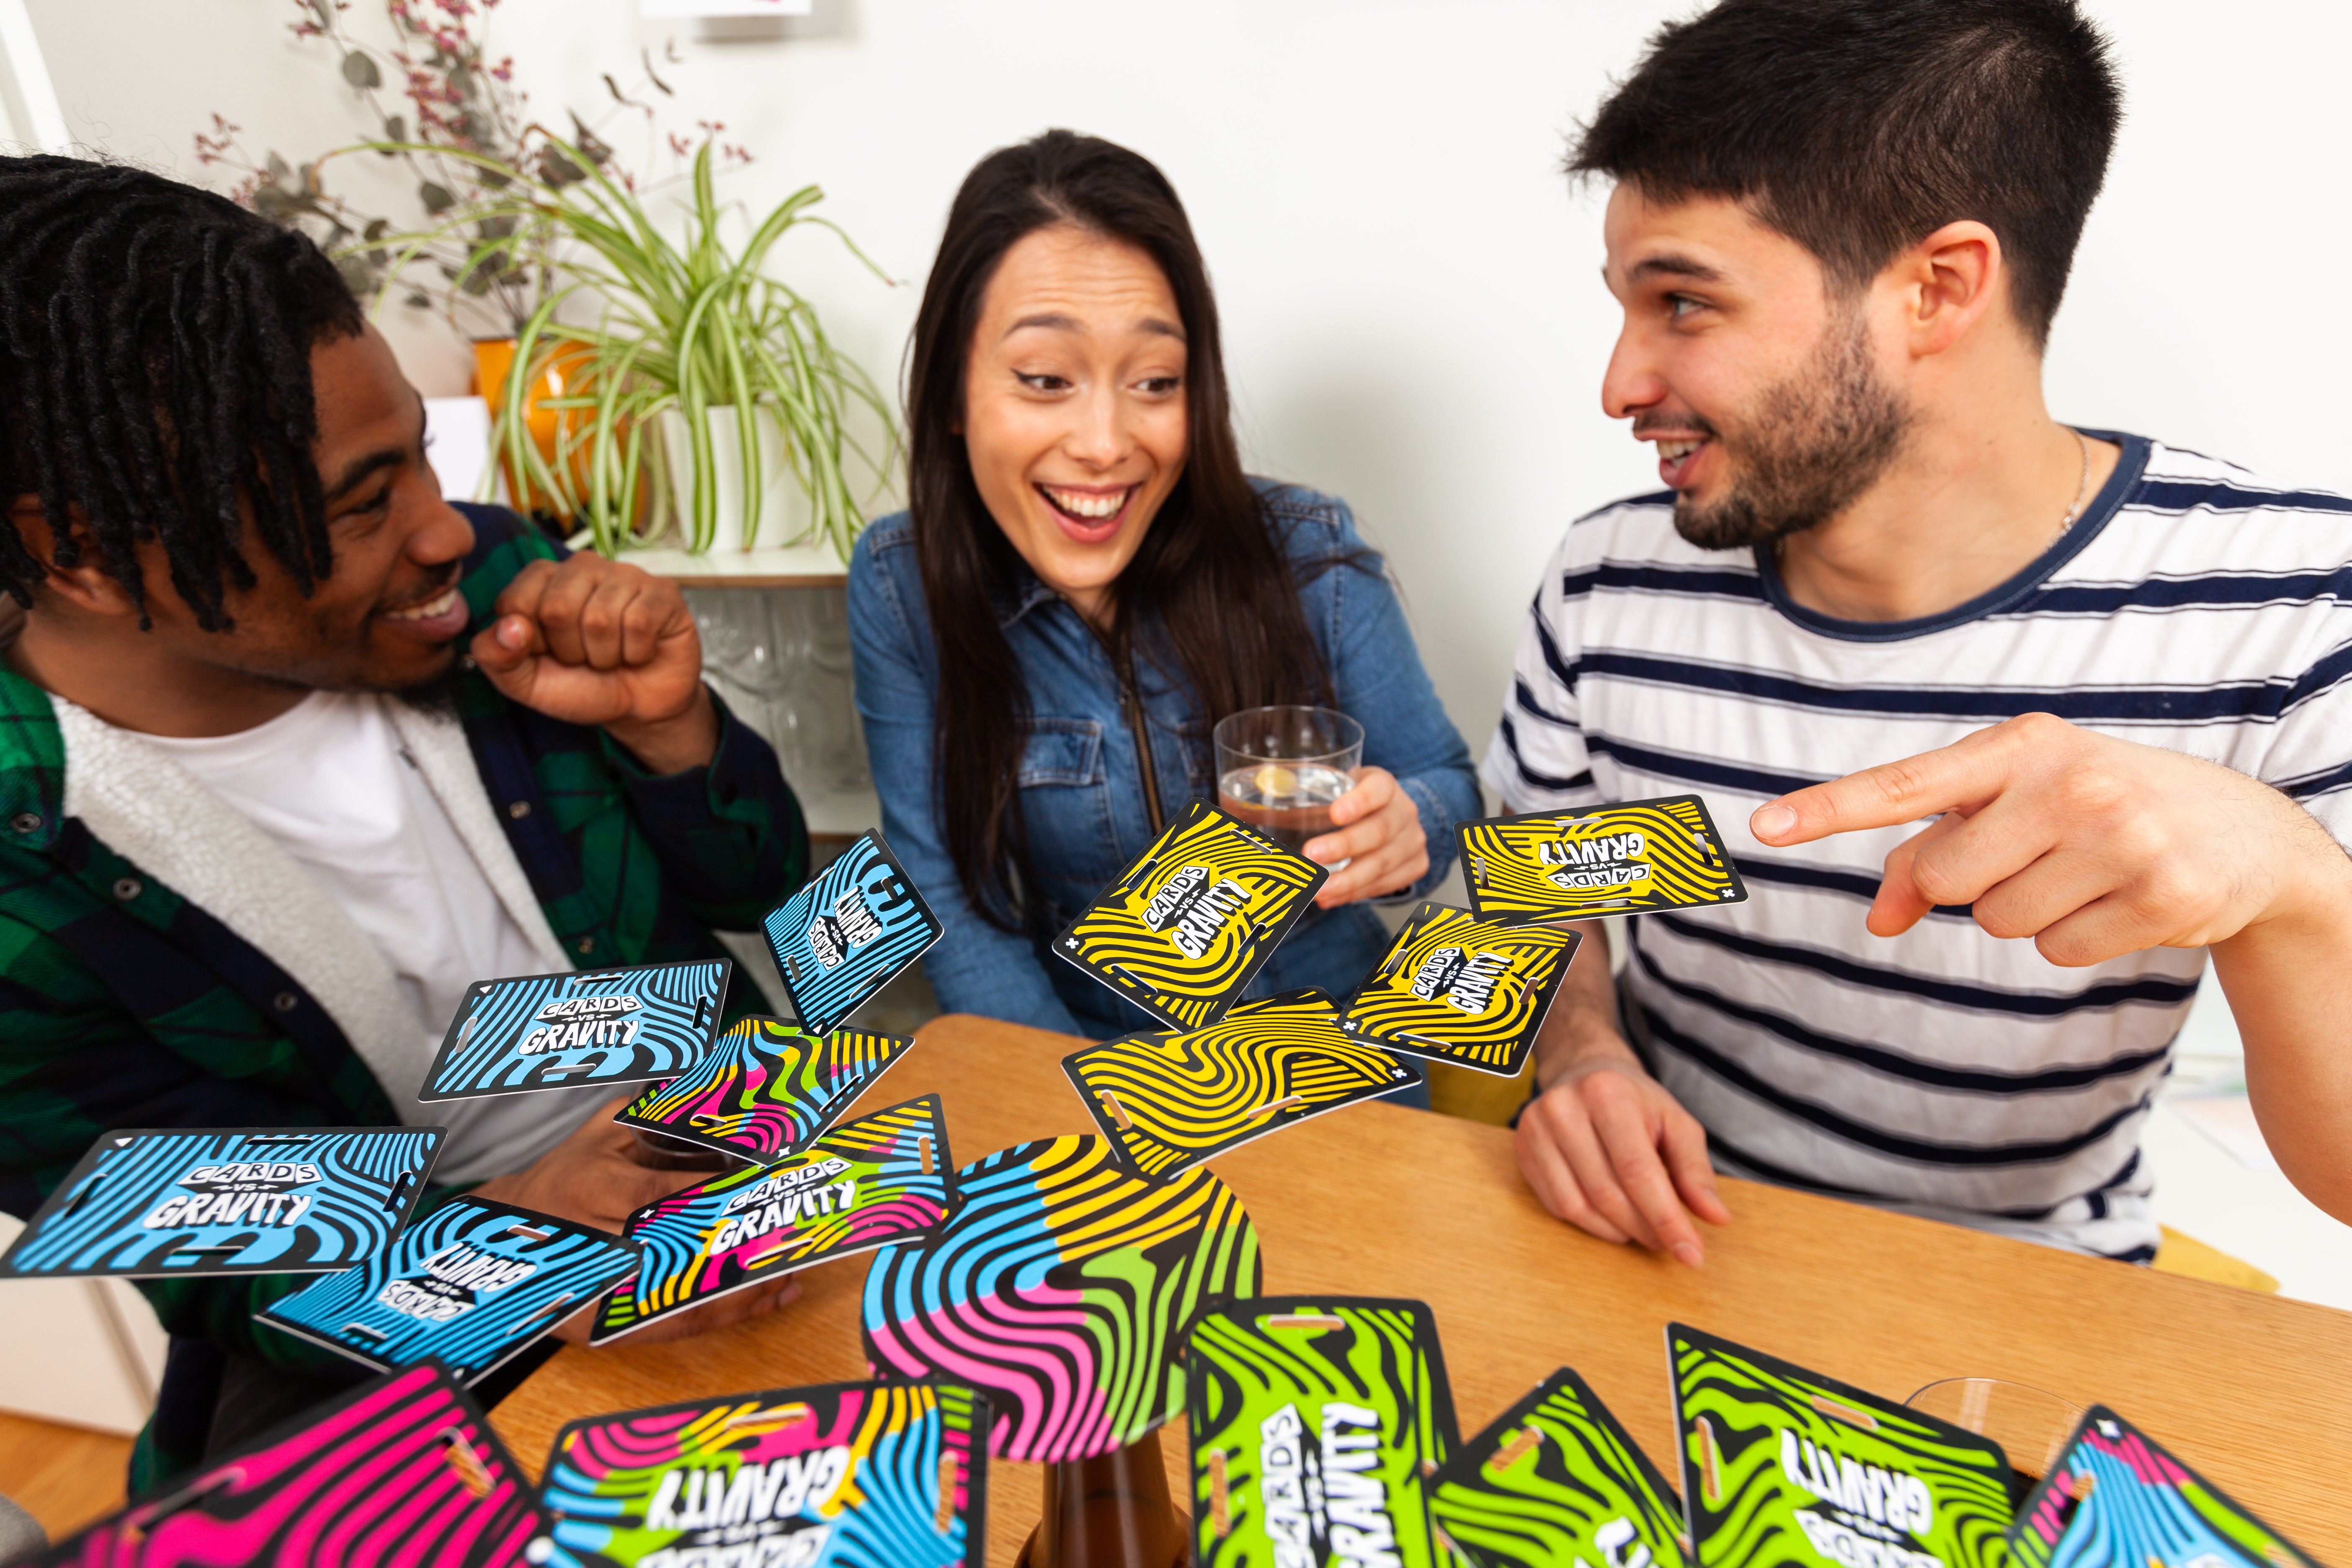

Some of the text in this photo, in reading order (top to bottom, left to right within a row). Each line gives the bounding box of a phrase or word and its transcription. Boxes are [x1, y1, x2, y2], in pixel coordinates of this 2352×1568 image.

[1539, 833, 1645, 865] GRAVITY
[1550, 865, 1649, 888] CARDS
[833, 886, 882, 949] GRAVITY
[1143, 867, 1207, 930] CARDS
[1179, 897, 1194, 909] VS
[832, 929, 841, 941] VS
[1171, 878, 1252, 960] GRAVITY
[809, 918, 843, 969] CARDS
[1411, 947, 1460, 999] CARDS
[1444, 970, 1457, 980] VS
[1446, 951, 1514, 1014] GRAVITY
[539, 996, 640, 1017] CARDS
[518, 1020, 640, 1055] GRAVITY
[183, 1163, 320, 1183] CARDS
[233, 1183, 257, 1191] VS
[725, 1158, 849, 1213] CARDS
[142, 1192, 313, 1229] GRAVITY
[773, 1189, 796, 1202] VS
[709, 1179, 856, 1256] GRAVITY
[419, 1242, 538, 1293] GRAVITY
[381, 1281, 471, 1320] CARDS
[646, 1445, 851, 1532] GRAVITY
[1780, 1427, 1933, 1536] GRAVITY
